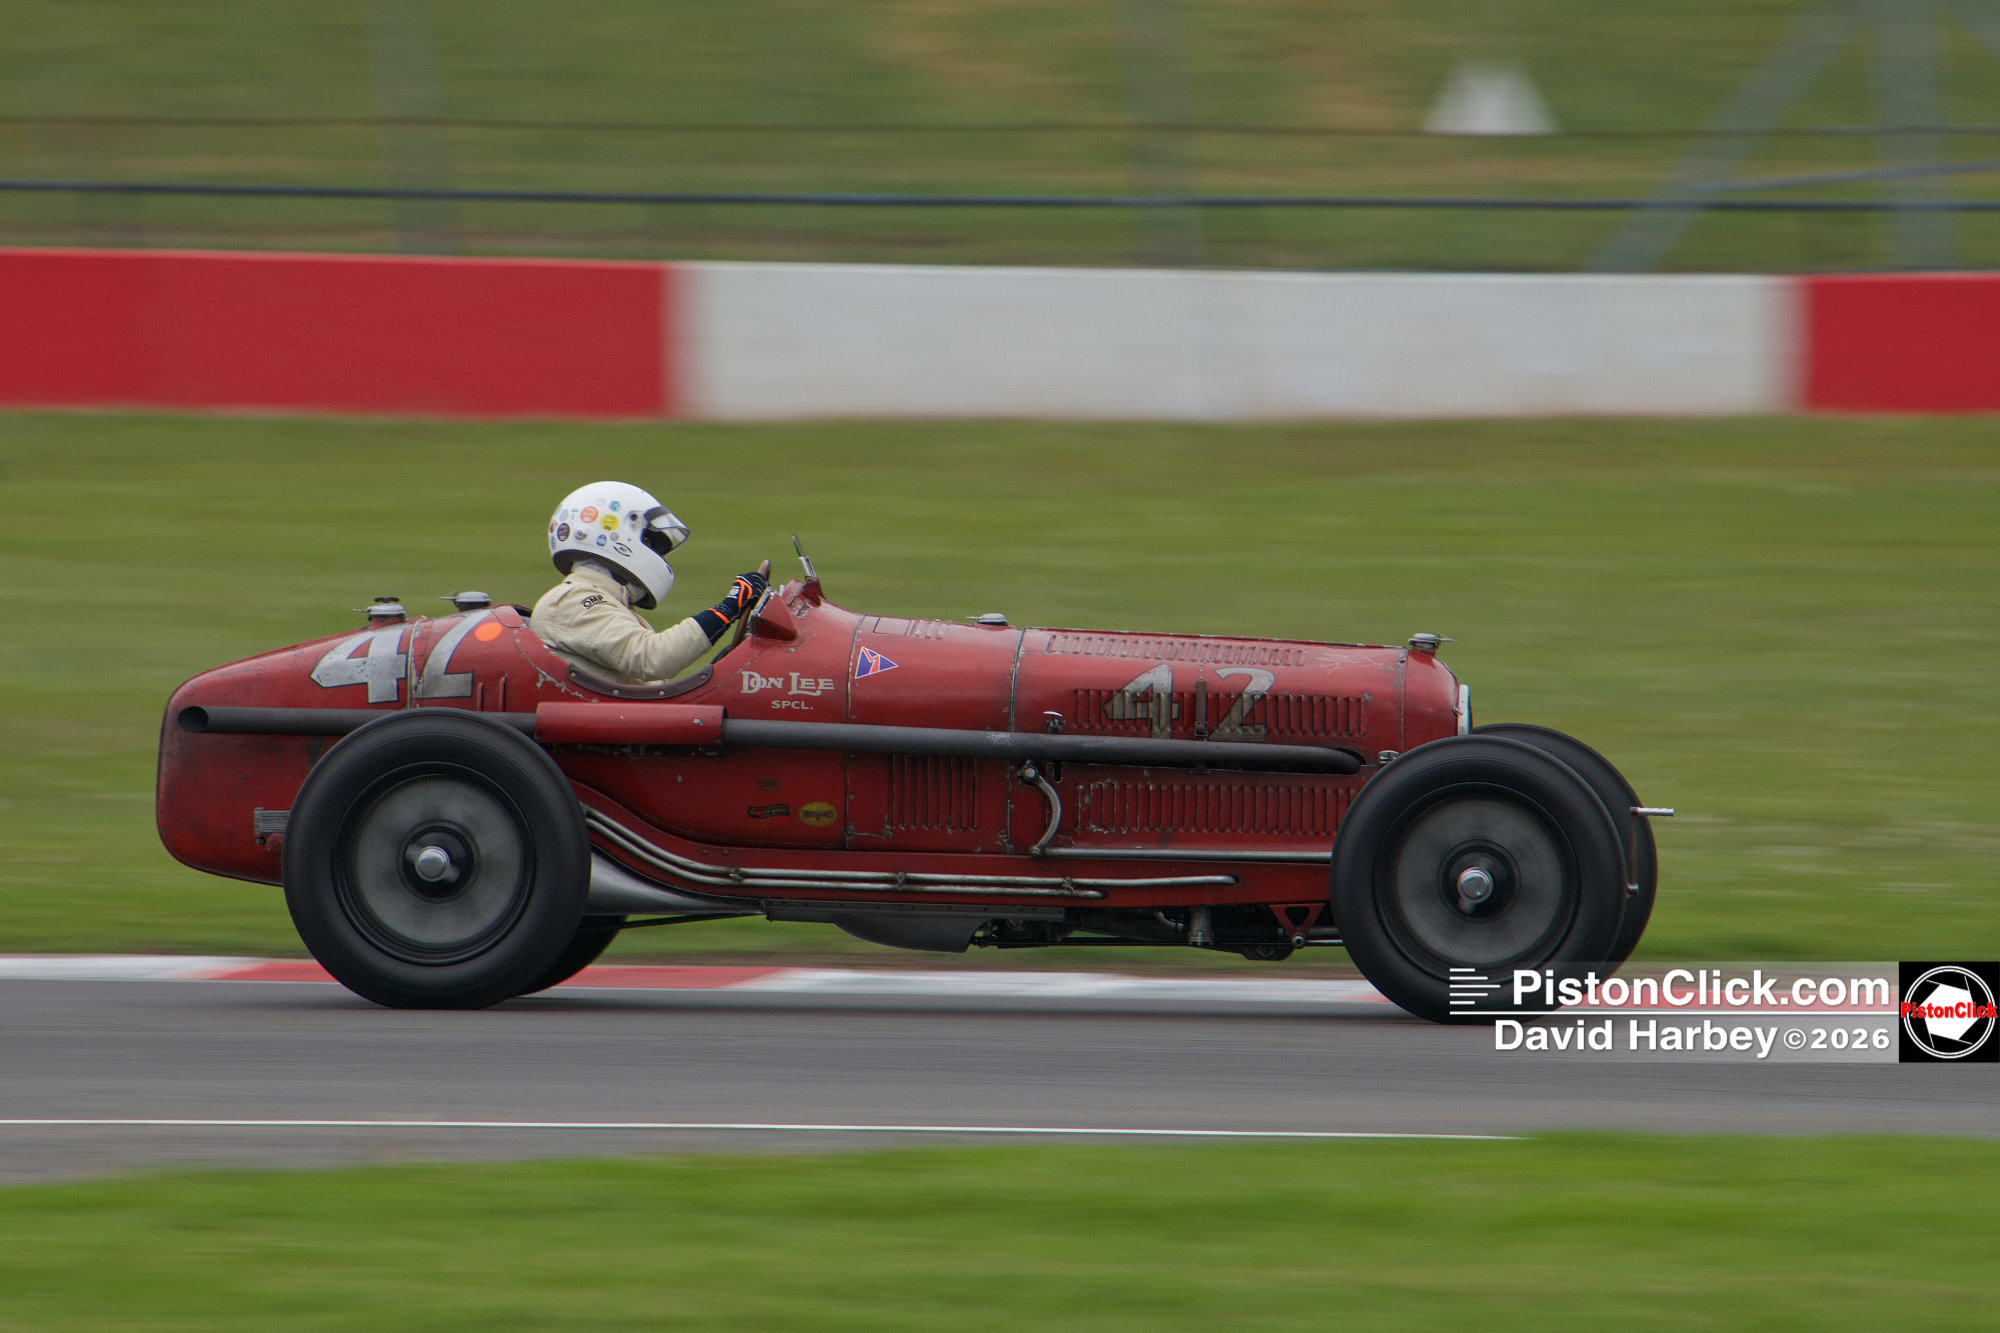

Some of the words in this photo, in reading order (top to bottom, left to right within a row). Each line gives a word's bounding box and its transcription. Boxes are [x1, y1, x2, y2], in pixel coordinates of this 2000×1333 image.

[582, 594, 604, 609] OMP
[771, 700, 814, 710] SPCL.
[1102, 663, 1276, 743] 42
